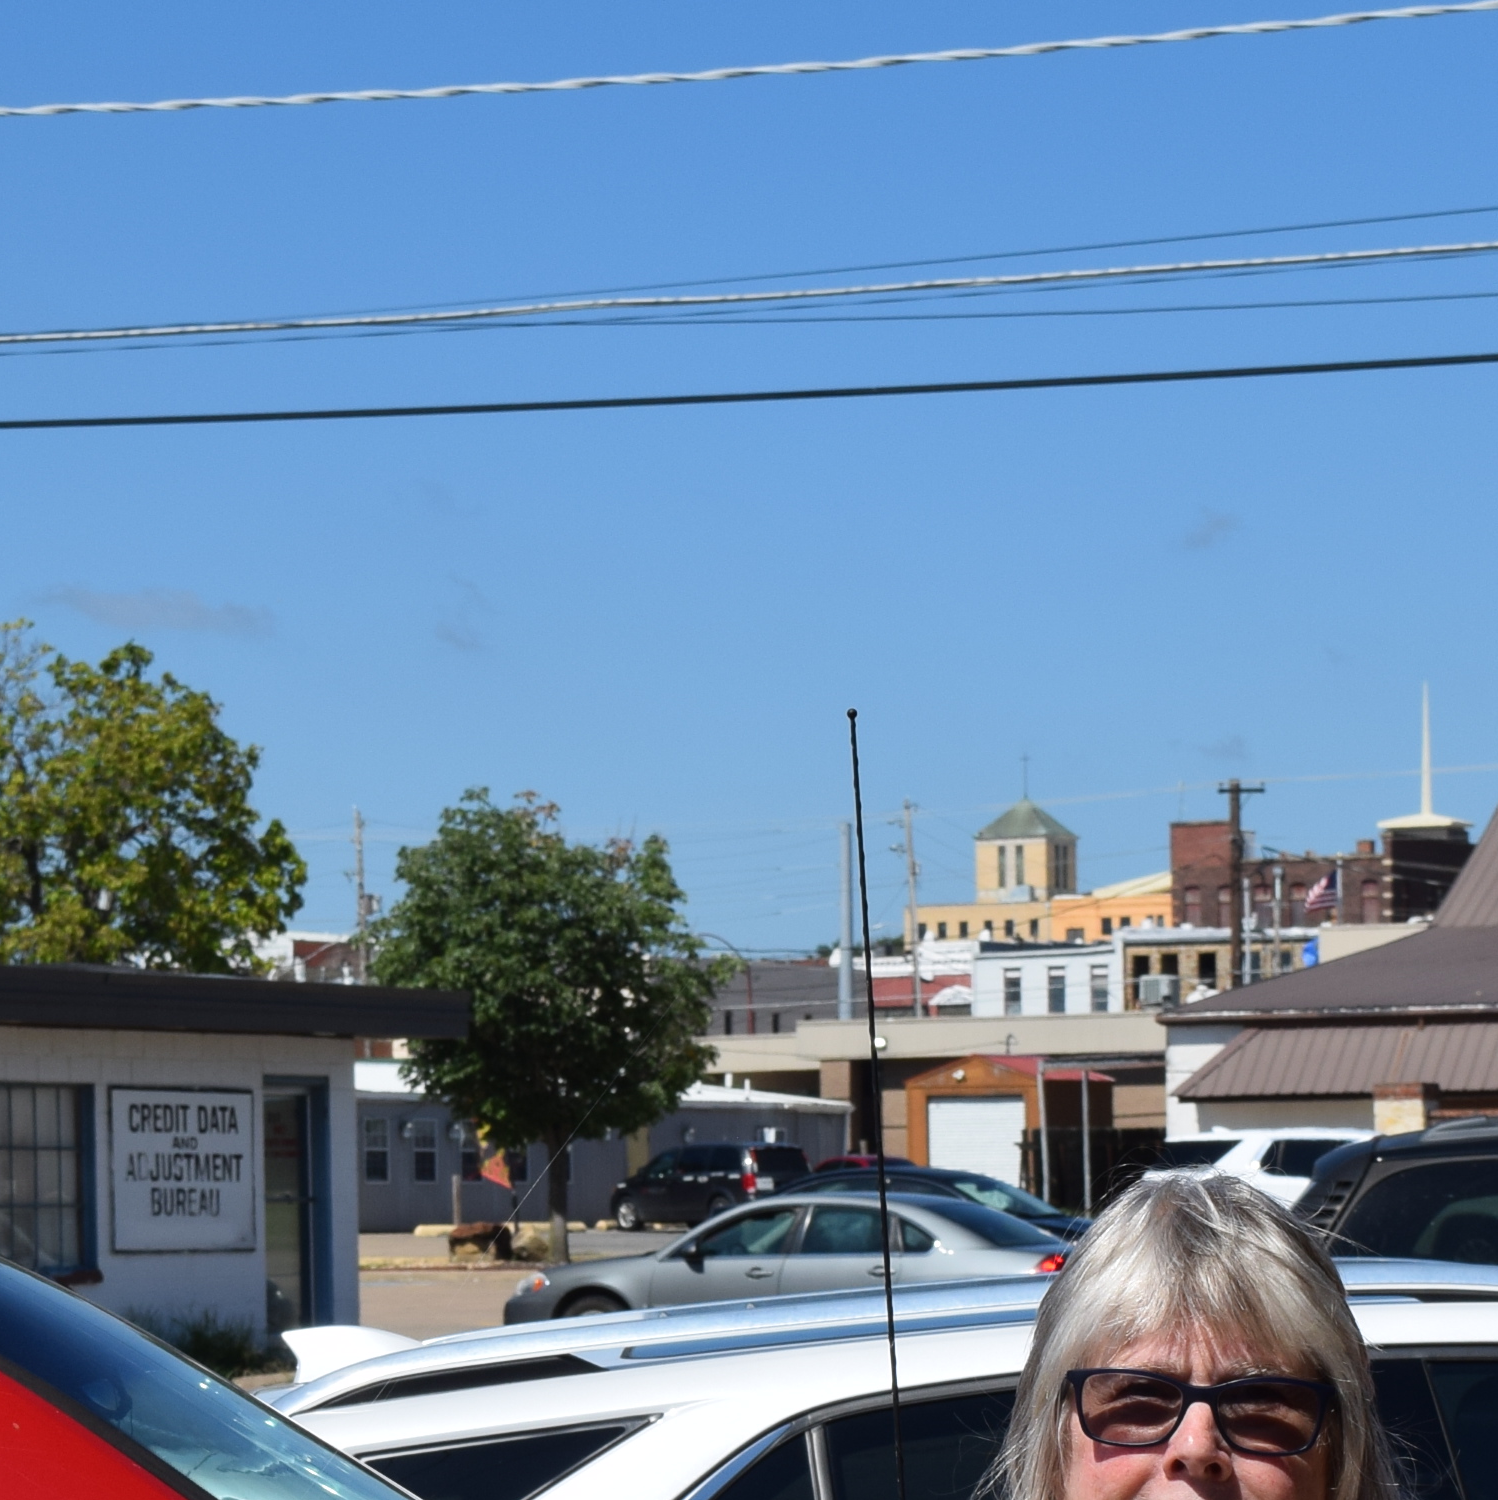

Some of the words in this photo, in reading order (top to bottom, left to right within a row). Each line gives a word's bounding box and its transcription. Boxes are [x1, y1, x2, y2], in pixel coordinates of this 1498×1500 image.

[128, 1103, 190, 1133] CREDIT
[197, 1104, 239, 1134] DATA
[172, 1136, 199, 1150] AND
[125, 1152, 243, 1182] ADJUSTMENT
[151, 1187, 220, 1217] BUREAU
